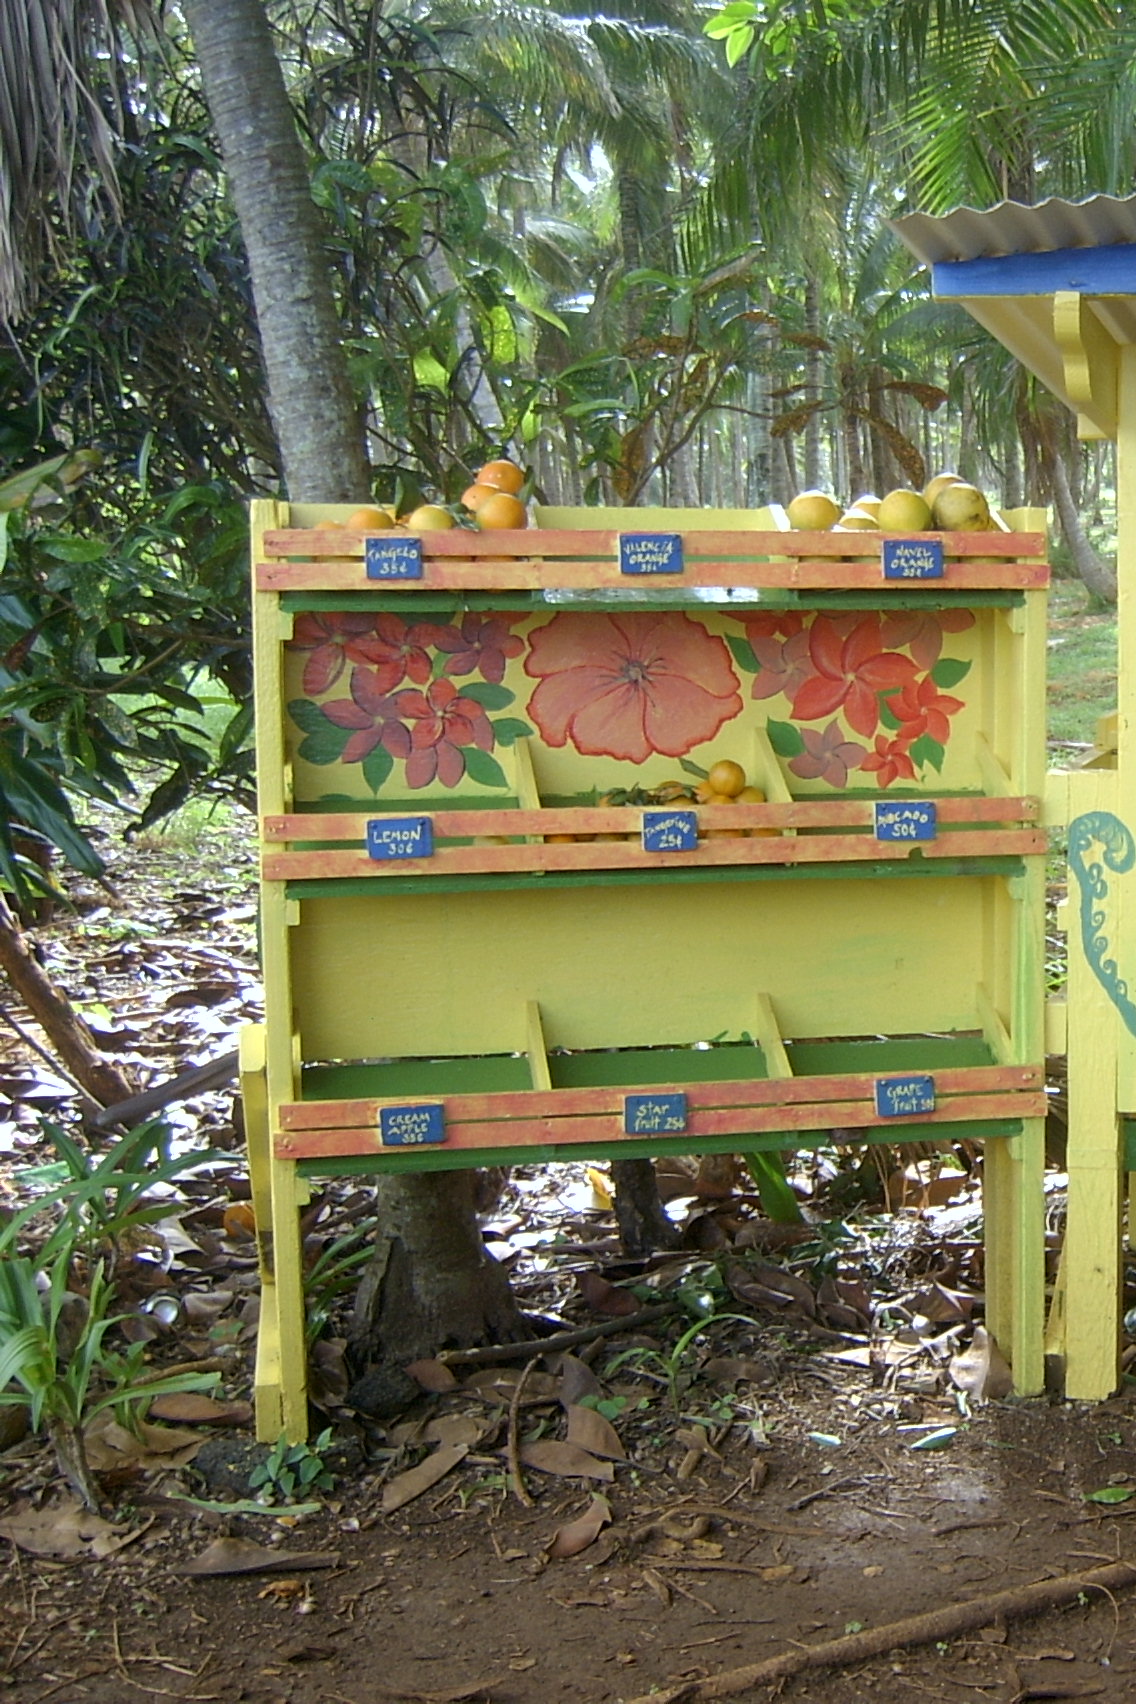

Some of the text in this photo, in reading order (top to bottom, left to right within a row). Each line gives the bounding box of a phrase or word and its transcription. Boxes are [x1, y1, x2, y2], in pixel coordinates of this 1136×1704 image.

[368, 545, 418, 562] TANGELO
[895, 544, 932, 558] NAVEL
[629, 552, 669, 566] ORANGE
[890, 557, 935, 571] ORANGE
[373, 824, 421, 844] LEMON
[388, 1112, 431, 1126] CREAM
[387, 1122, 429, 1135] APPLE
